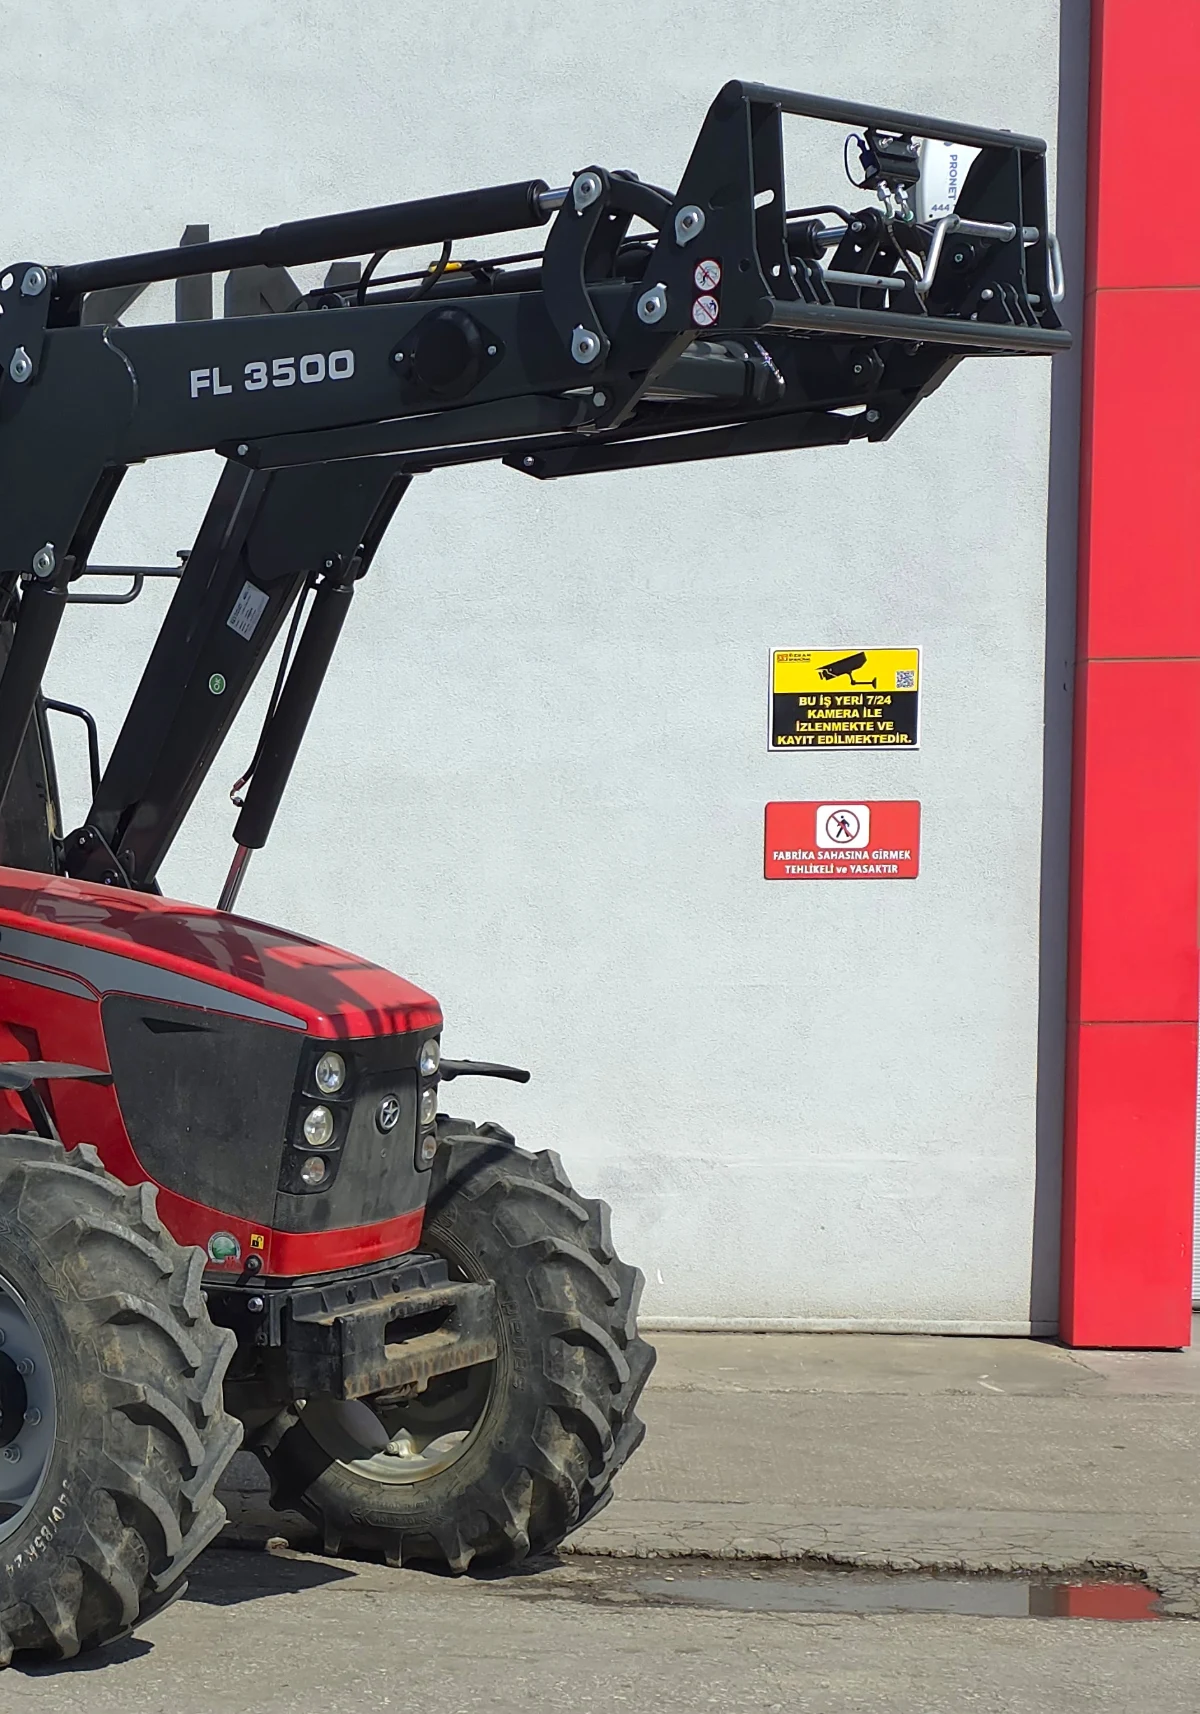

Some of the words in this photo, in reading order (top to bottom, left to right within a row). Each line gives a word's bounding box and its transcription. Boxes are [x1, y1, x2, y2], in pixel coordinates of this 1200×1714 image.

[948, 154, 958, 201] PRONET
[931, 204, 950, 212] 444
[190, 367, 233, 398] FL
[244, 349, 355, 391] 3500
[799, 696, 816, 706] BU
[820, 694, 832, 708] İŞ
[835, 693, 863, 706] YERİ
[866, 695, 892, 705] 7/24
[807, 708, 860, 719] KAMERA
[863, 706, 883, 718] İLE
[796, 720, 874, 732] İZLENMEKTE
[877, 721, 894, 731] VE
[777, 735, 815, 745] KAYIT
[817, 732, 912, 745] EDİLMEKTEDİR.
[773, 849, 815, 860] FABRİKA
[817, 851, 870, 860] SAHASINA
[872, 849, 911, 860] GİRMEK
[785, 863, 834, 874] TEHLİKELİ
[836, 866, 848, 874] ve
[849, 864, 898, 874] YASAKTIR
